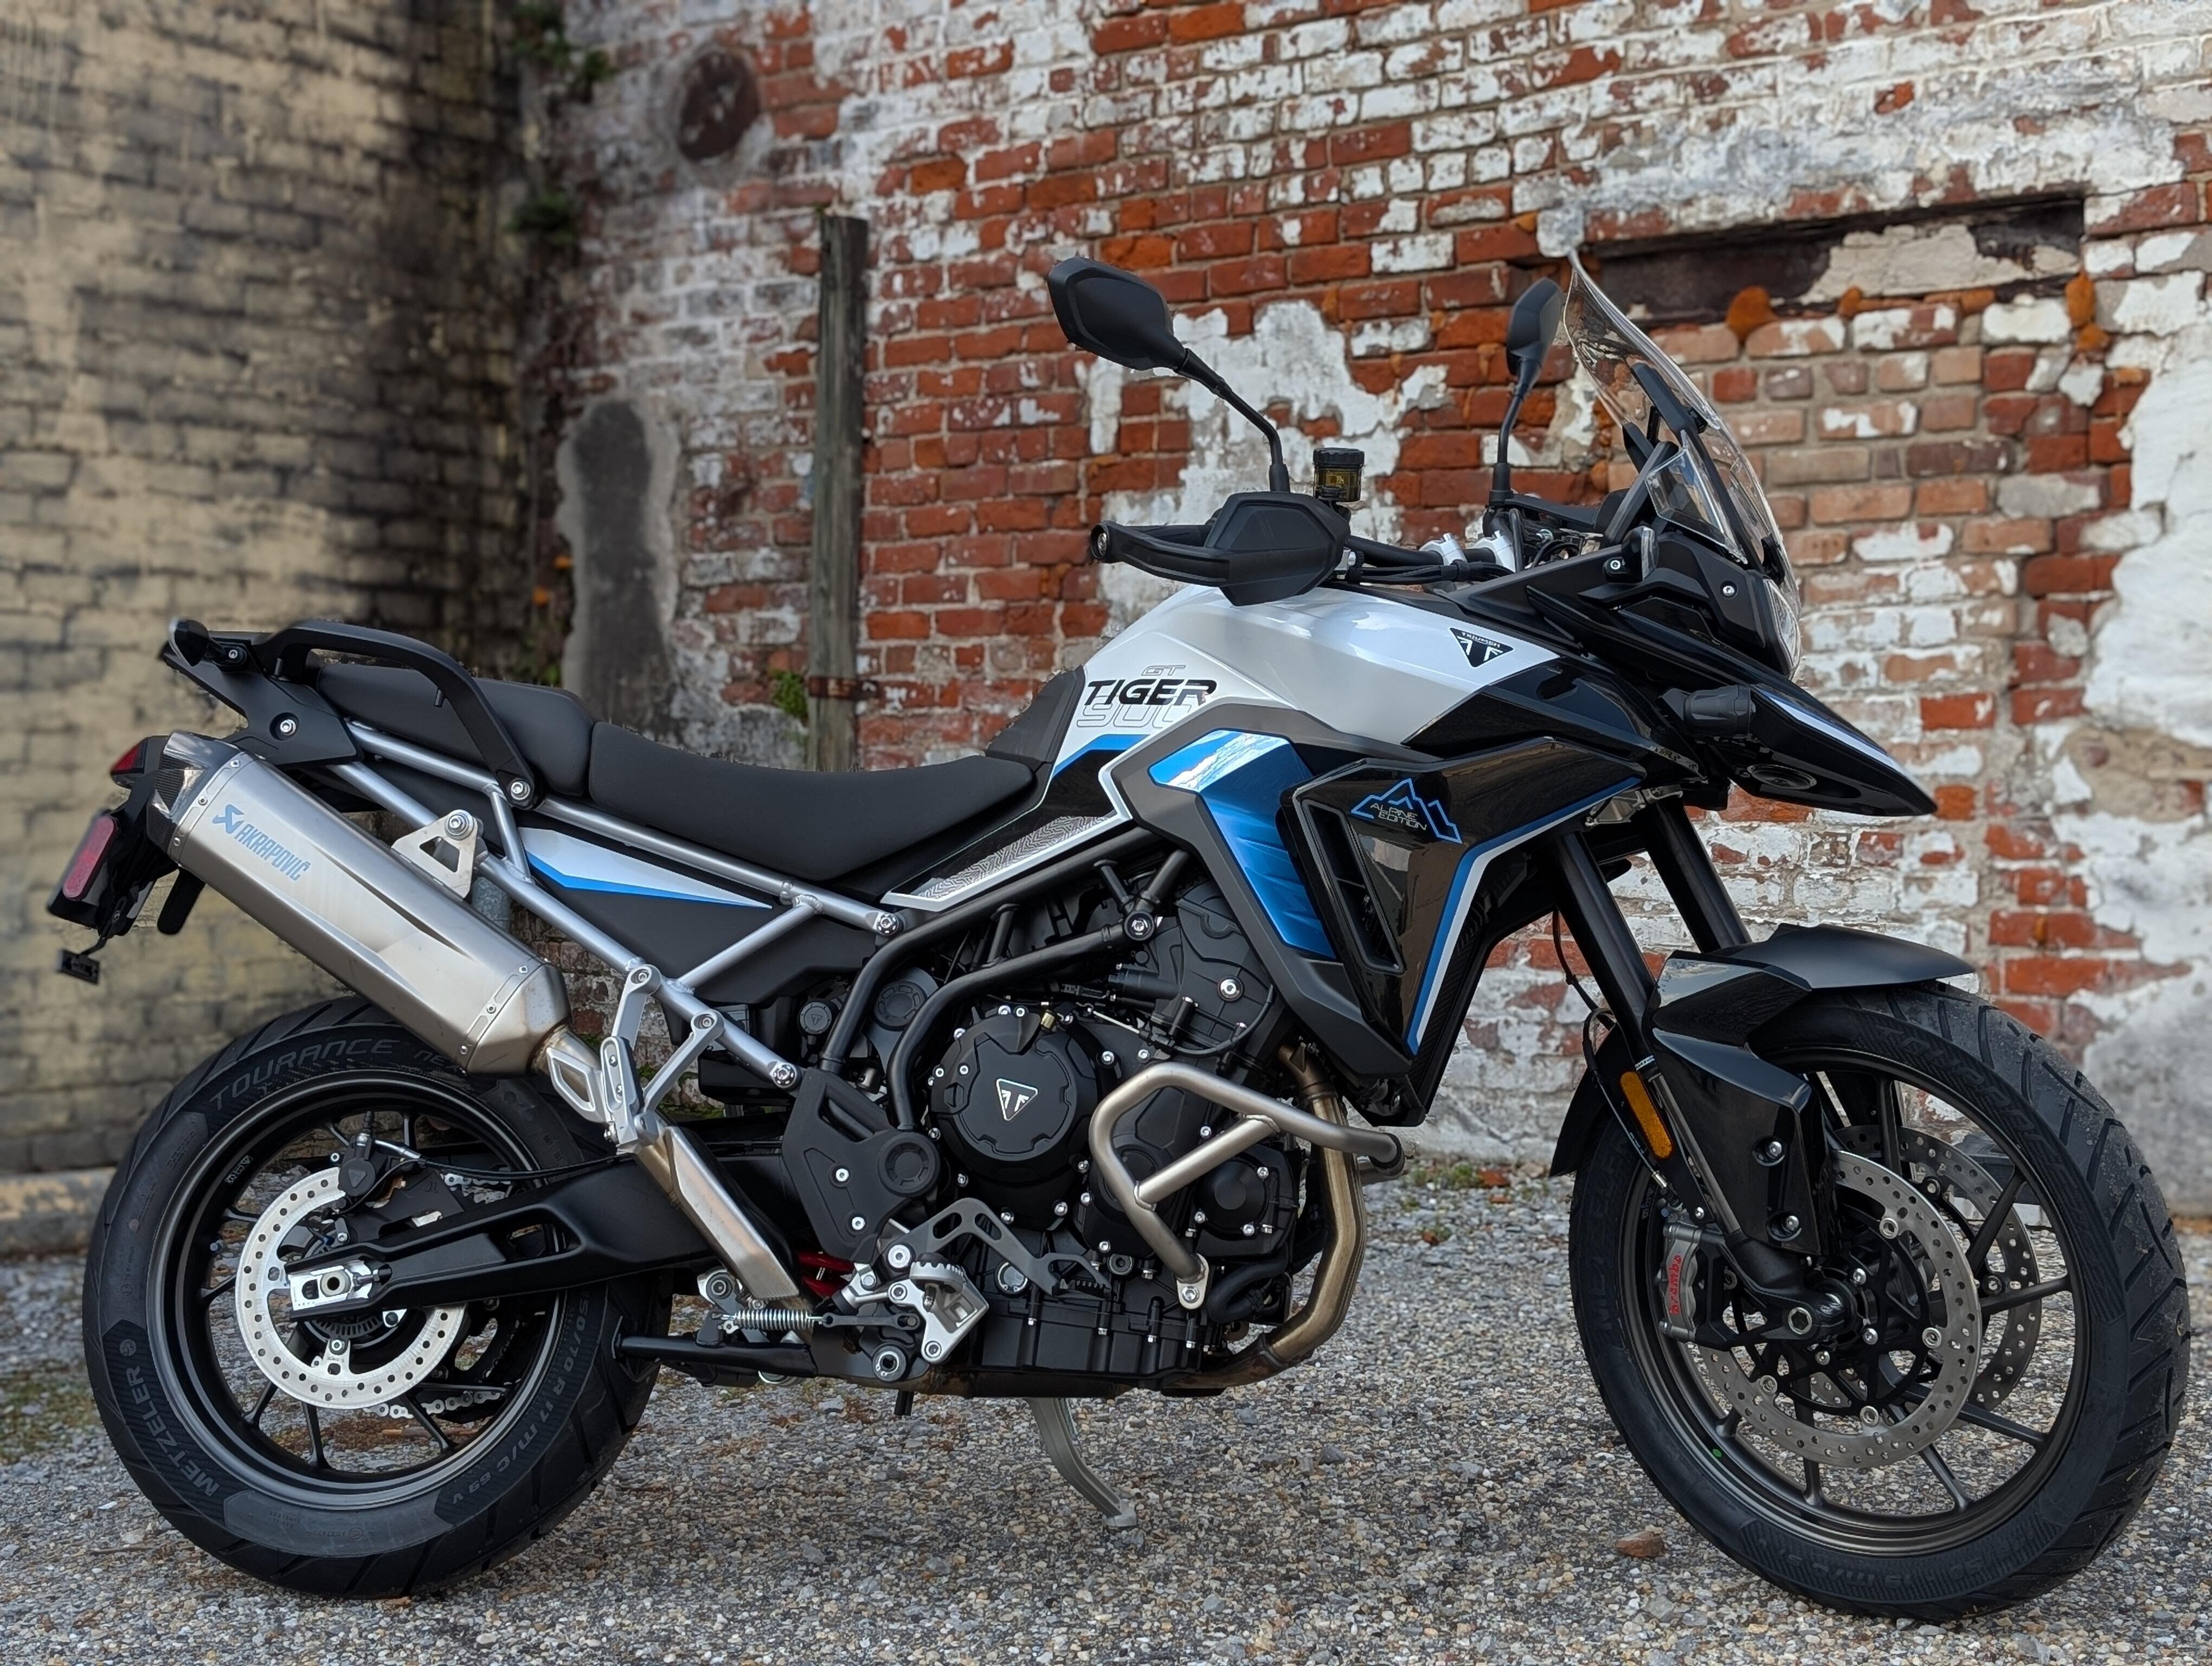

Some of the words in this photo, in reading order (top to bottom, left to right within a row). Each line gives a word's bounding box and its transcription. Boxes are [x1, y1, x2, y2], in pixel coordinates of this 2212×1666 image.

[1141, 664, 1186, 676] GT
[1084, 678, 1217, 706] TIGER
[1370, 802, 1419, 819] ALPINE
[1378, 810, 1427, 831] EDITION
[209, 1039, 400, 1111] TOURANCE
[555, 1376, 566, 1396] R
[539, 1400, 554, 1423] 17
[126, 1365, 220, 1497] METZELER
[468, 1471, 492, 1493] 69
[451, 1492, 464, 1505] V
